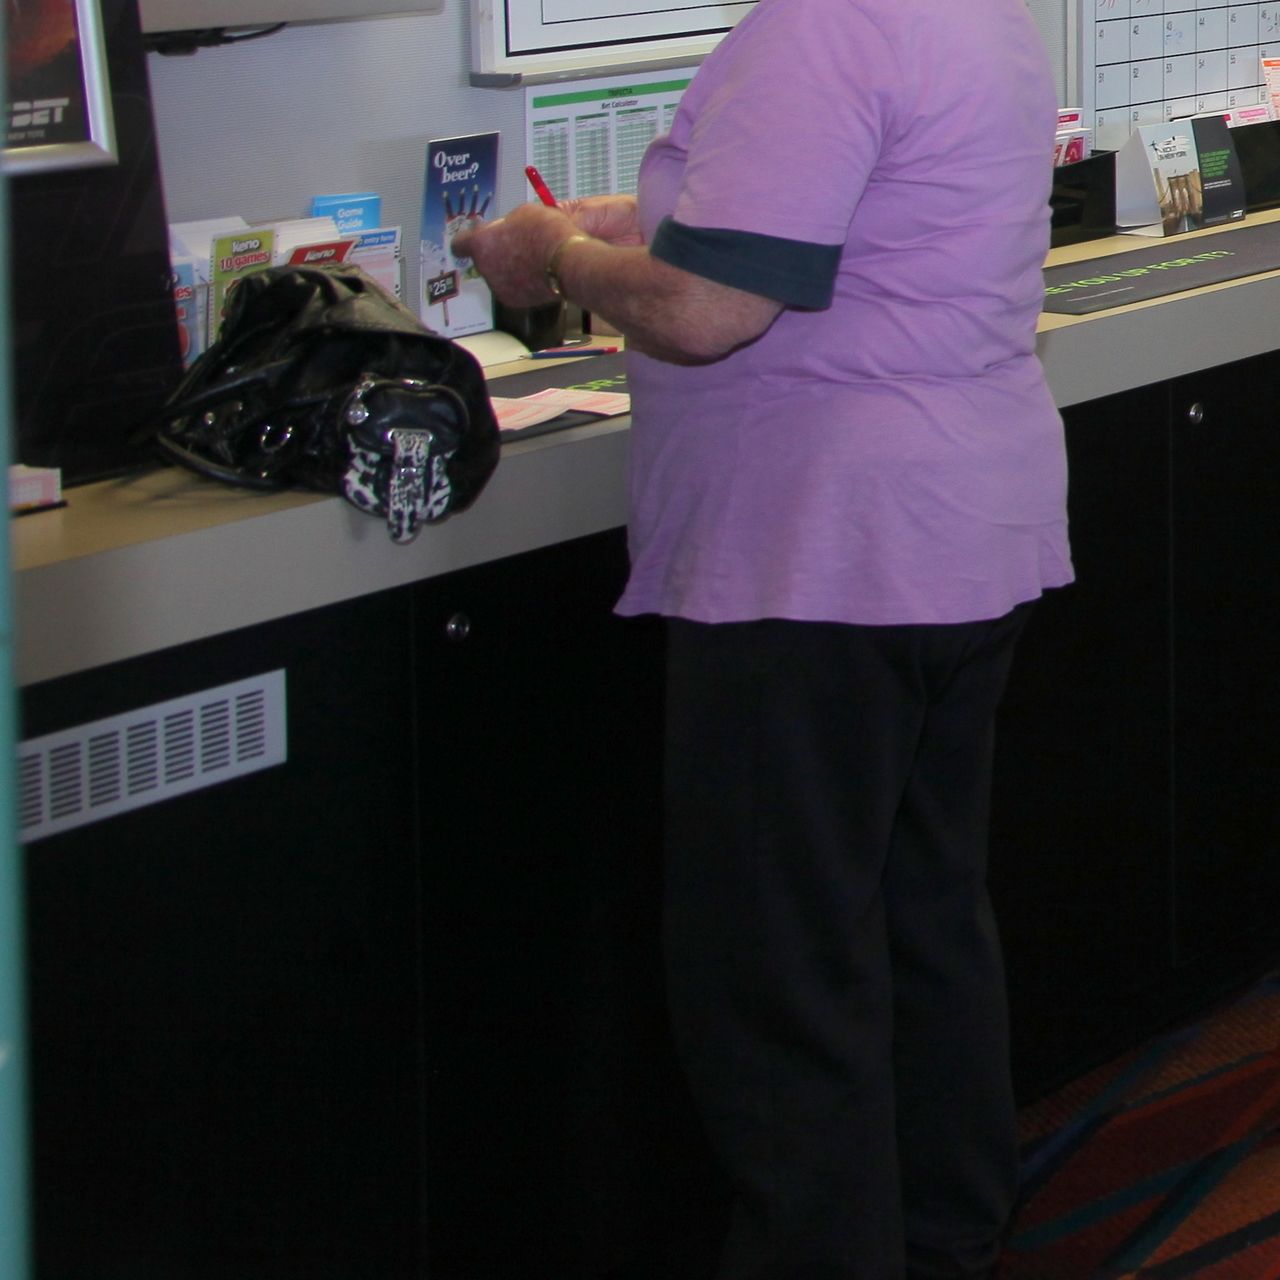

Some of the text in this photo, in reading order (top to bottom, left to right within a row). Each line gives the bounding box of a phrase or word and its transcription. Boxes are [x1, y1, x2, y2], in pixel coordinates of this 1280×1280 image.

[601, 99, 638, 110] Bet Calculator
[434, 151, 470, 169] Over
[441, 162, 479, 183] beer?
[337, 207, 364, 219] Game
[337, 219, 363, 231] Guide
[364, 236, 381, 246] entry
[220, 251, 271, 269] 10 games
